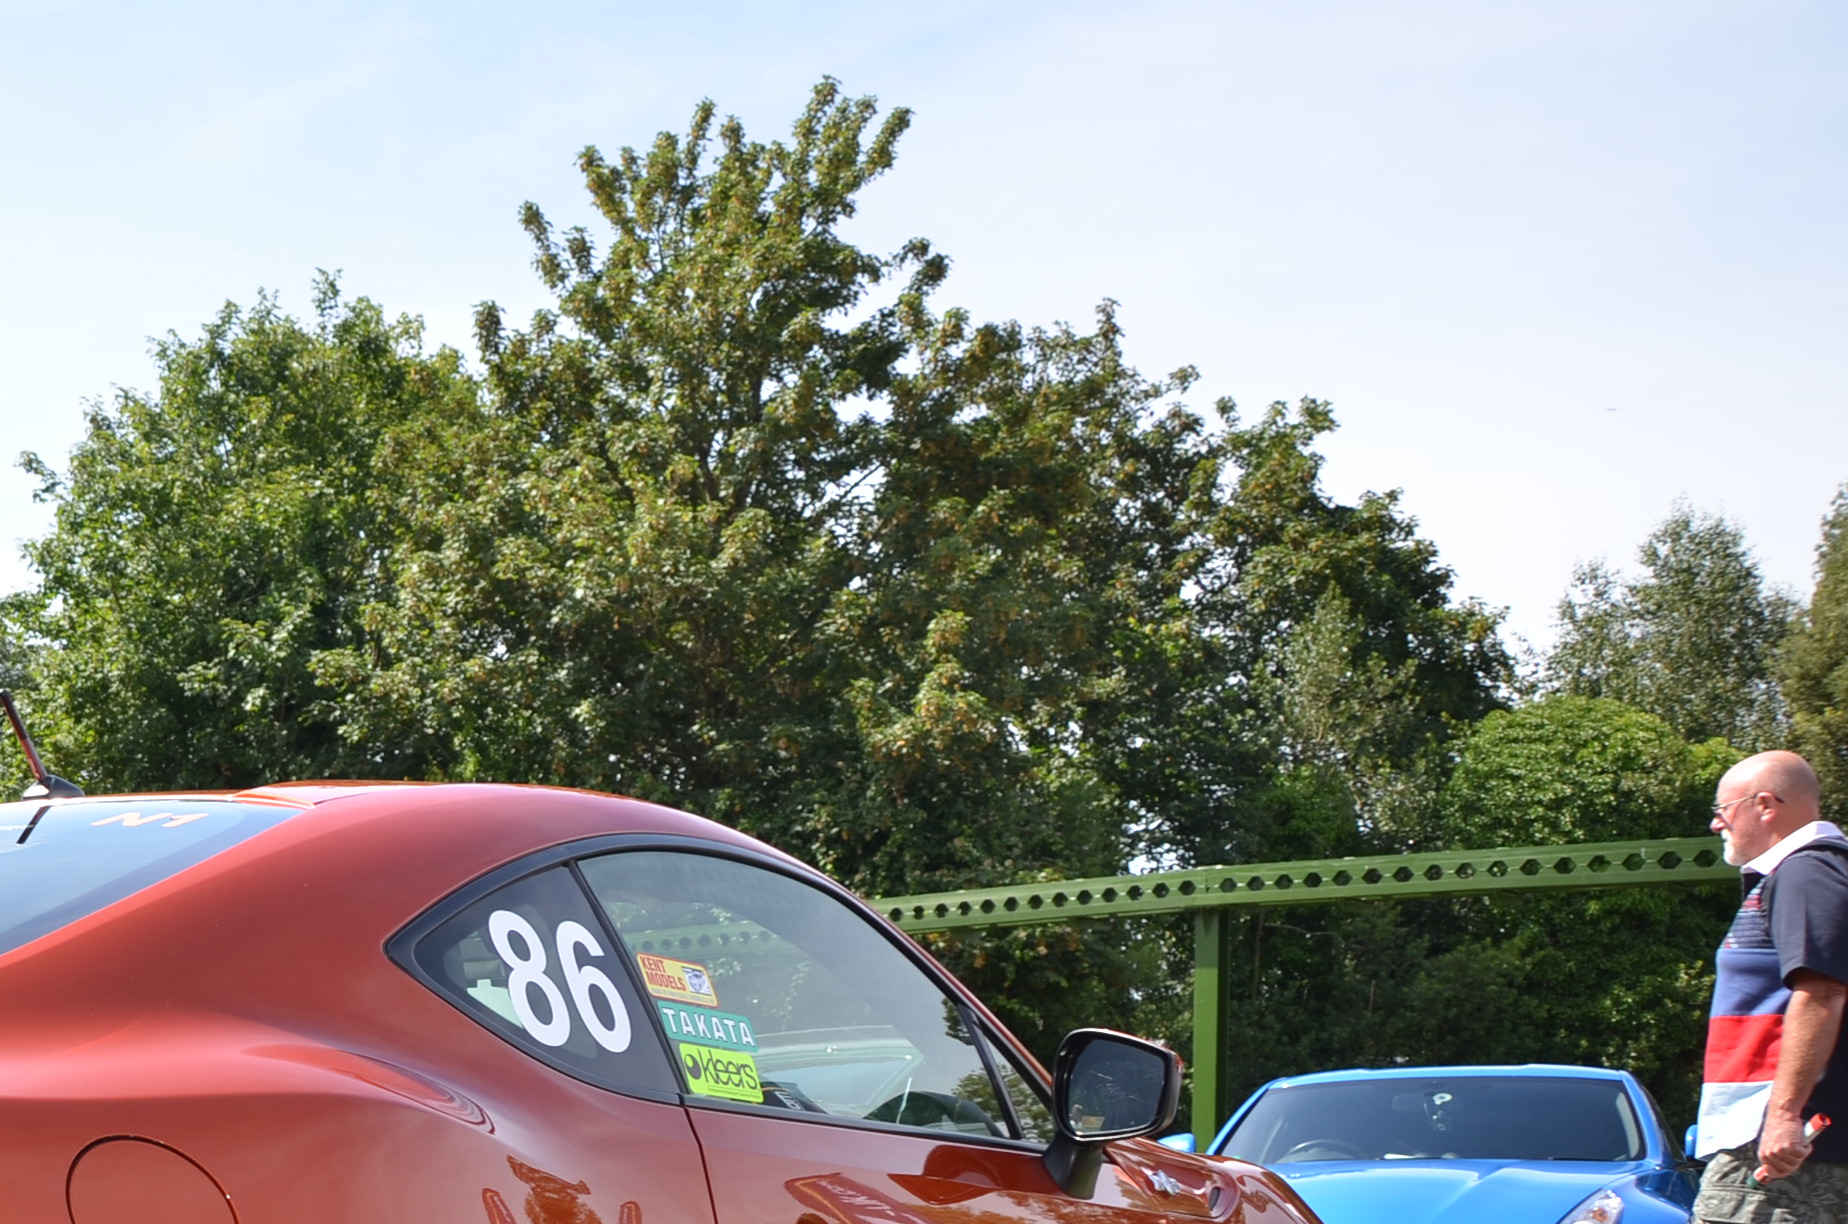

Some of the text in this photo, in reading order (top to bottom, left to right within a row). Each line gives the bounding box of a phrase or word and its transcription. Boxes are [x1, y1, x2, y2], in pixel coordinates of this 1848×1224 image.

[488, 909, 632, 1053] 86
[639, 956, 666, 974] KENT
[645, 971, 687, 992] MODELS
[662, 1007, 756, 1047] TAKATA
[696, 1048, 758, 1091] kleers
